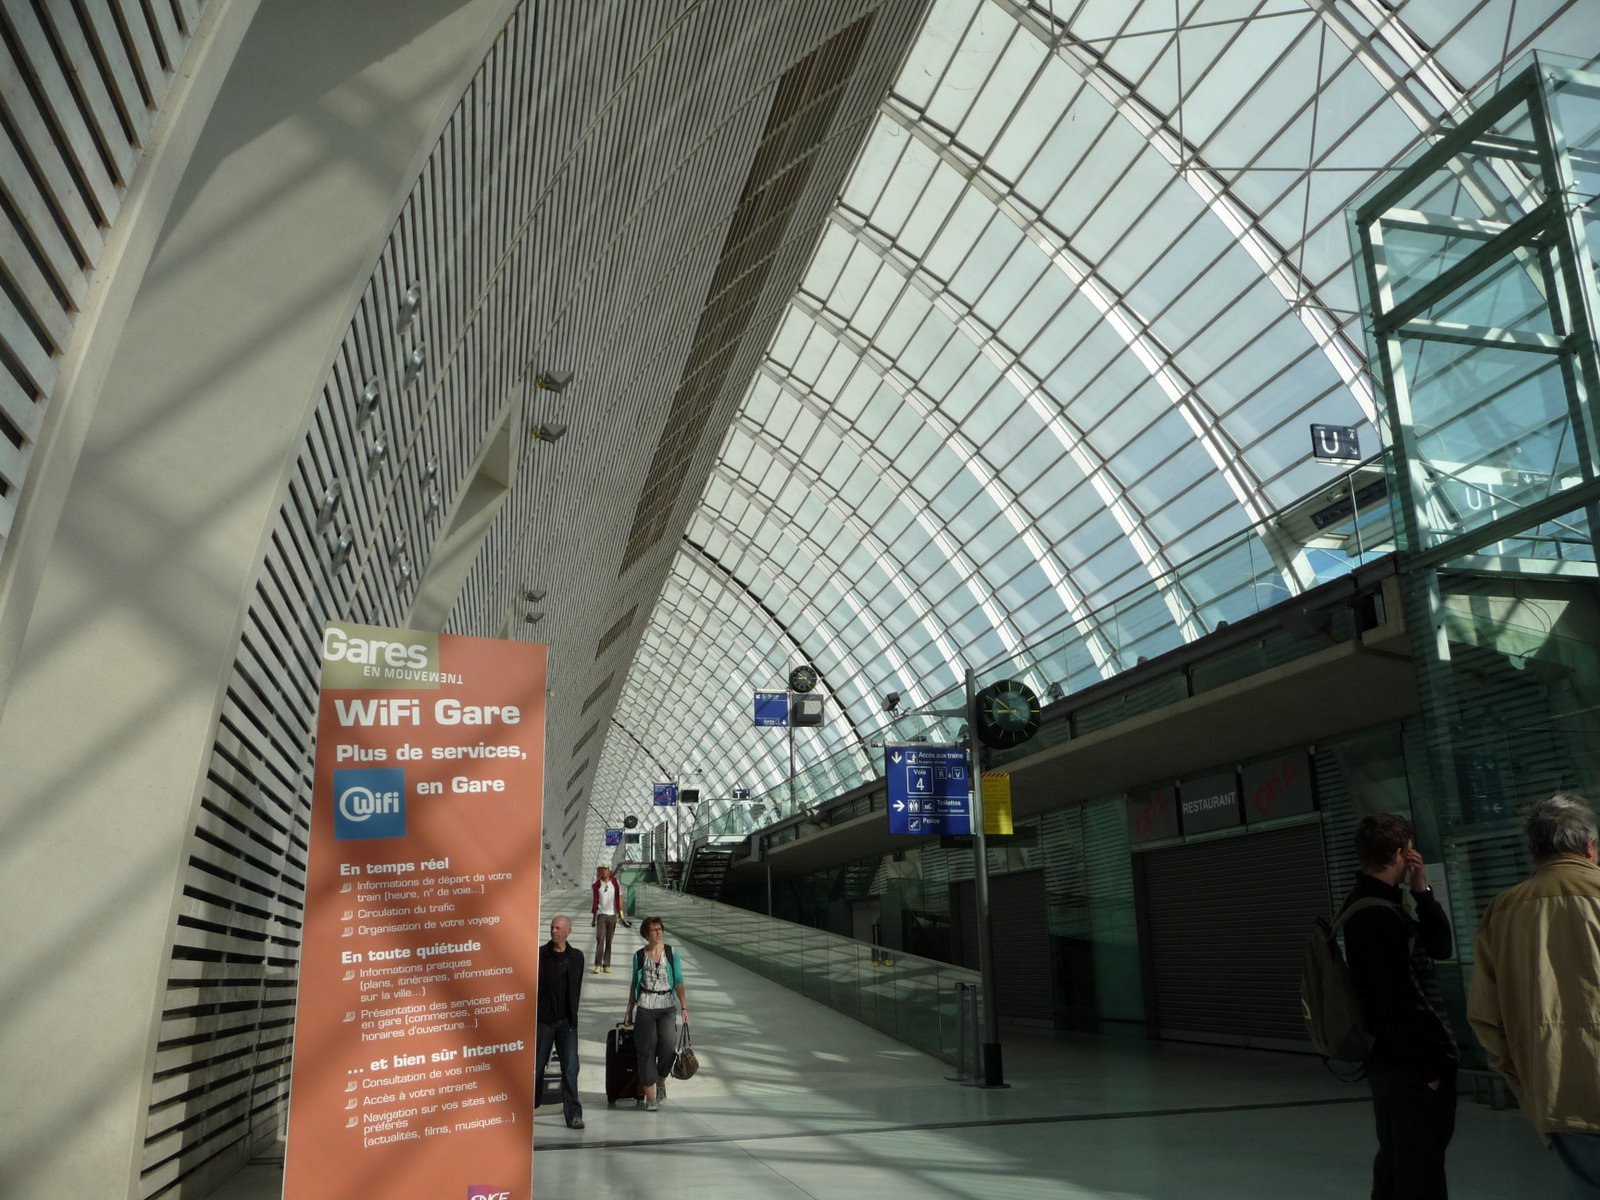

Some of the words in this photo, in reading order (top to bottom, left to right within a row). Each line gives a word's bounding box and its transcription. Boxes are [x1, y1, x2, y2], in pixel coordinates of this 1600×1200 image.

[1320, 430, 1339, 454] U
[323, 628, 427, 668] Gares
[364, 666, 380, 678] EN
[384, 667, 464, 685] MOUVEMENT
[334, 698, 420, 727] WiFi
[434, 698, 521, 726] Gare
[336, 744, 388, 762] Plus
[396, 744, 423, 760] de
[432, 742, 527, 760] services,
[416, 780, 443, 796] en
[451, 776, 506, 794] Gare
[916, 777, 924, 791] 4
[1182, 792, 1236, 814] RESTAURANT
[340, 863, 360, 876] En
[366, 862, 415, 875] temps
[420, 858, 449, 871] réel
[357, 878, 420, 890] Informations
[423, 876, 435, 886] de
[438, 874, 470, 885] départ
[473, 872, 485, 882] de
[488, 872, 512, 881] votre
[357, 892, 382, 902] train
[437, 886, 449, 896] de
[358, 906, 410, 919] Circulation
[414, 904, 426, 914] du
[429, 902, 455, 912] trafic
[358, 922, 421, 936] Organisation
[424, 920, 436, 929] de
[440, 918, 465, 928] votre
[468, 915, 500, 926] voyage
[342, 951, 362, 964] En
[368, 947, 411, 962] toute
[416, 940, 481, 959] quiétude
[360, 964, 422, 978] Informations
[426, 959, 472, 973] pratiques
[398, 974, 450, 987] itinéraires,
[454, 966, 513, 980] informations
[360, 992, 378, 1002] sur
[382, 990, 390, 1000] la
[361, 1003, 426, 1019] Présentation
[430, 1001, 448, 1011] des
[451, 996, 491, 1008] services
[494, 992, 526, 1003] offerts
[361, 1020, 374, 1030] en
[378, 1017, 402, 1028] gare
[474, 1003, 510, 1015] accueil,
[362, 1028, 405, 1042] horaires
[370, 1060, 388, 1072] et
[393, 1053, 426, 1068] bien
[431, 1048, 458, 1064] sûr
[463, 1040, 524, 1058] Internet
[362, 1073, 426, 1089] Consultation
[429, 1069, 442, 1079] de
[444, 1067, 462, 1077] vos
[466, 1062, 491, 1073] mails
[363, 1092, 396, 1106] Accès
[398, 1091, 406, 1100] à
[409, 1088, 436, 1099] votre
[439, 1081, 478, 1094] intranet
[364, 1108, 418, 1124] Navigation
[421, 1104, 438, 1114] sur
[441, 1101, 459, 1111] vos
[462, 1096, 486, 1108] sites
[488, 1092, 508, 1103] web
[364, 1118, 408, 1136] préférés
[424, 1126, 452, 1136] films,
